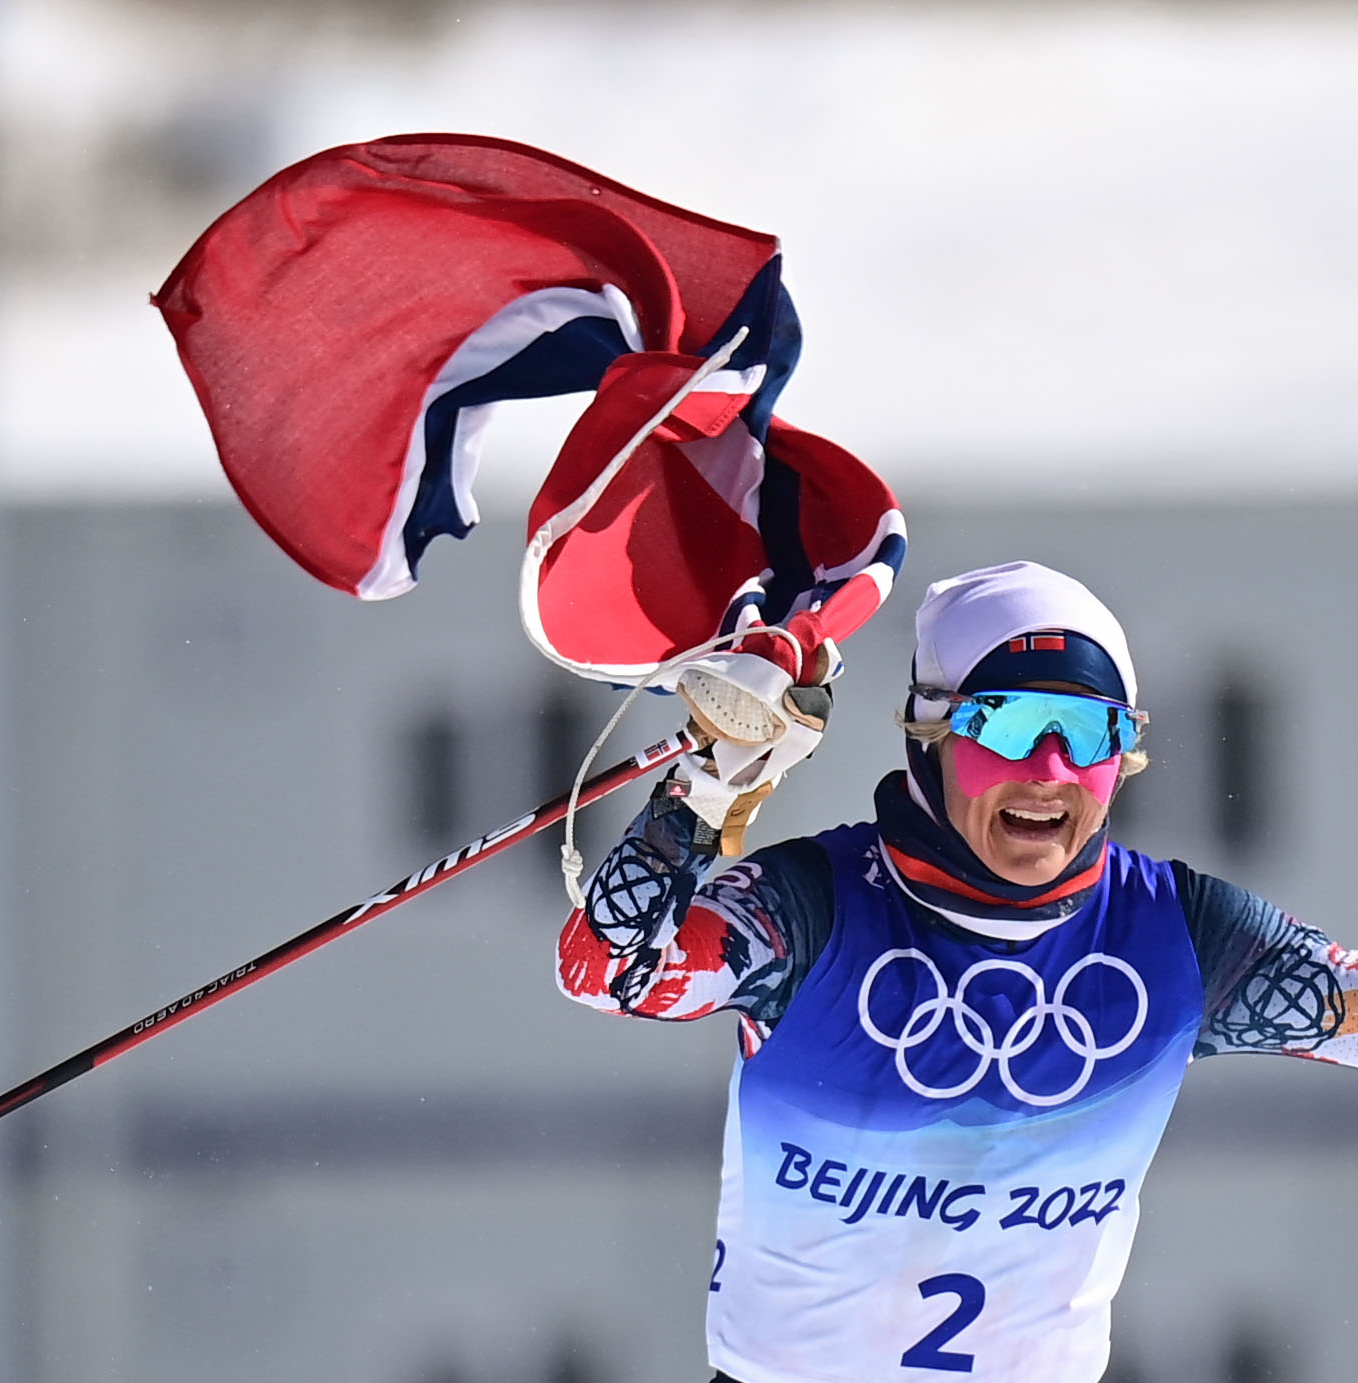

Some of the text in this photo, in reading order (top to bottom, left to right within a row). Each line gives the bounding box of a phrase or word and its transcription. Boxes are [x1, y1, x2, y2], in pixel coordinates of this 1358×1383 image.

[775, 1141, 1126, 1232] BEIJING 2022
[900, 1272, 986, 1373] 2
